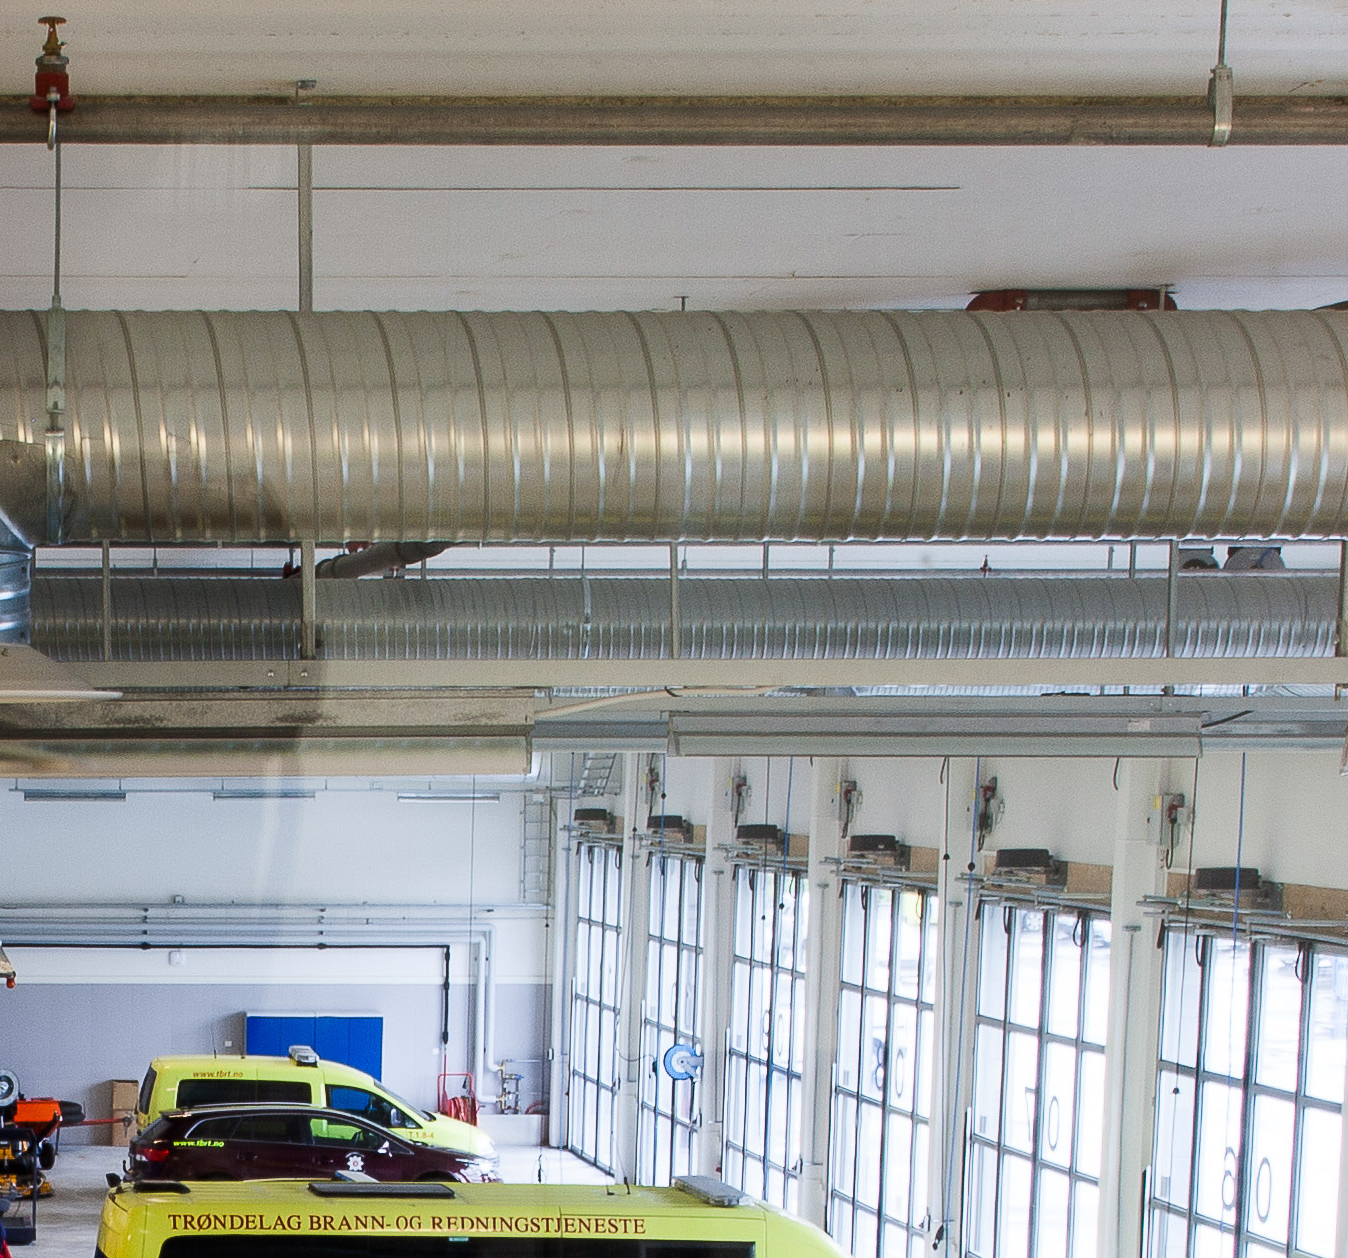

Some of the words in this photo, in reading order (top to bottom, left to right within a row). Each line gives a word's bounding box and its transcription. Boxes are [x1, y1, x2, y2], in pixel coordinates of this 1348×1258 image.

[168, 1213, 302, 1232] TRØNDELAG
[396, 1215, 422, 1231] OG
[431, 1216, 647, 1234] REDNINGSTJENESTE
